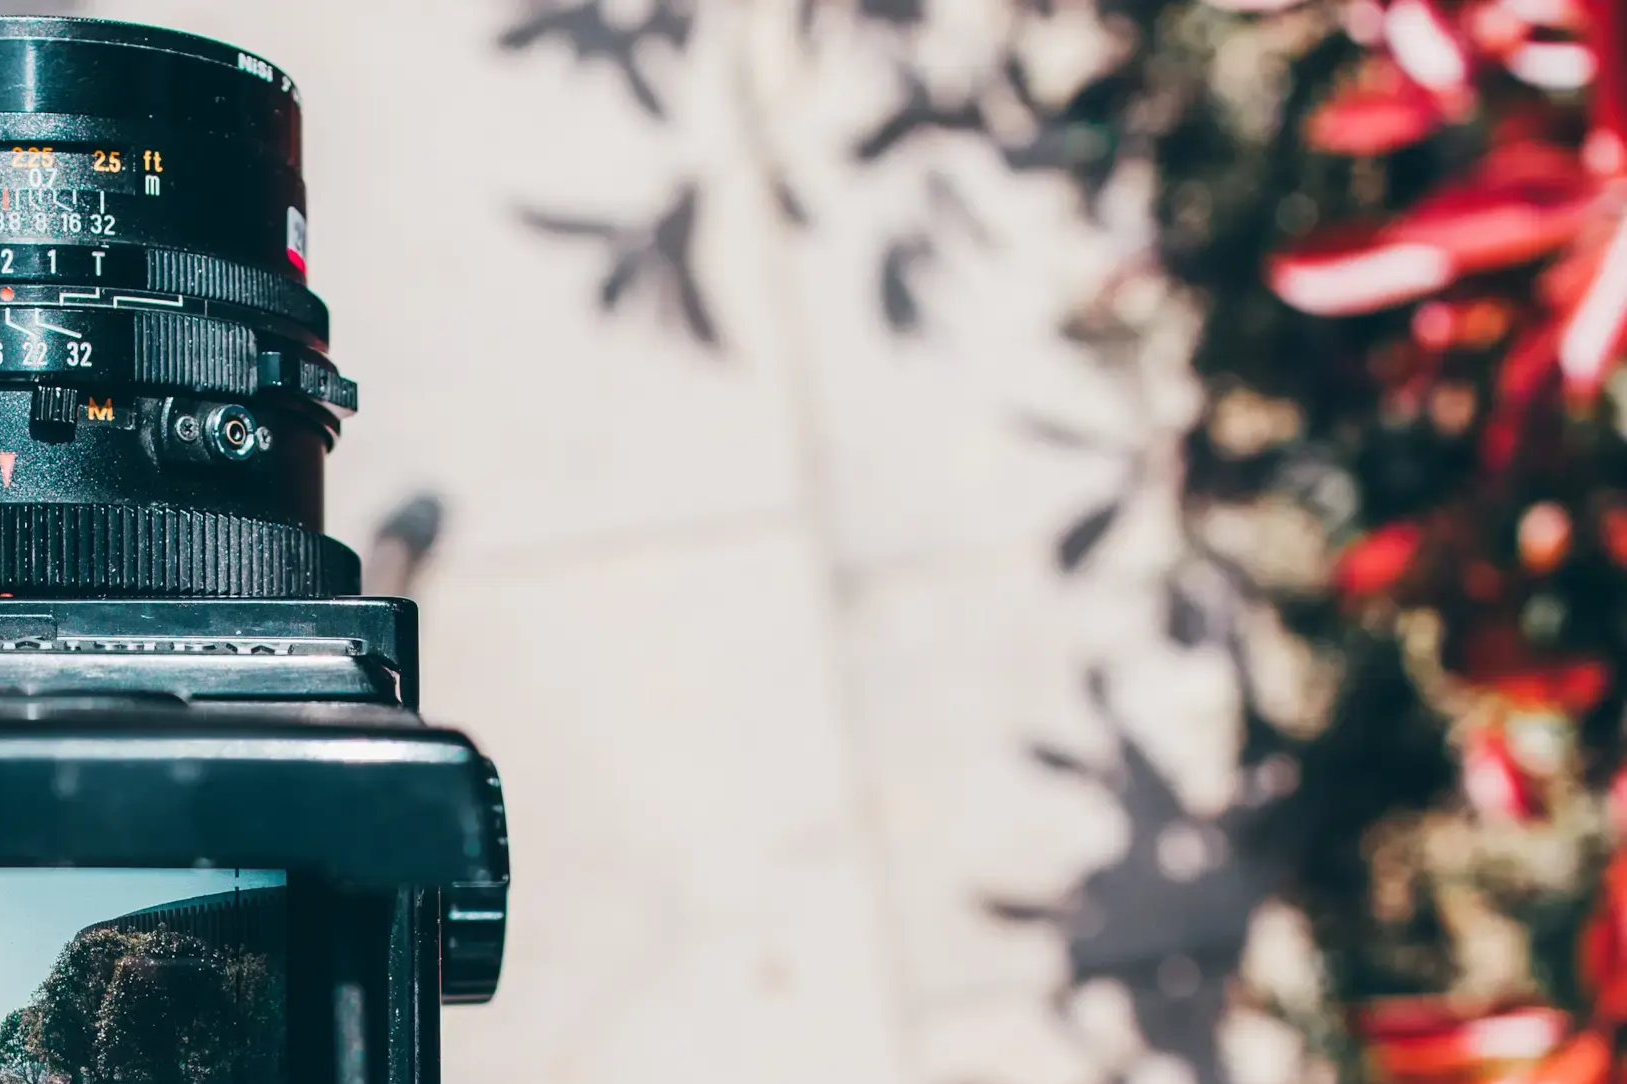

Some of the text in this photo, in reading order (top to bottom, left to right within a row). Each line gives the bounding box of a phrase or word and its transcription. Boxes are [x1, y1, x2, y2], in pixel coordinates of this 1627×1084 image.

[93, 150, 121, 173] 2.5
[143, 150, 163, 172] ft
[145, 175, 160, 196] m
[35, 212, 47, 231] 8
[62, 213, 82, 233] 16
[90, 214, 116, 235] 32
[0, 249, 15, 274] 2
[47, 249, 57, 274] 1
[91, 251, 106, 276] T
[22, 342, 48, 366] 22
[66, 341, 93, 367] 32
[87, 397, 114, 421] M
